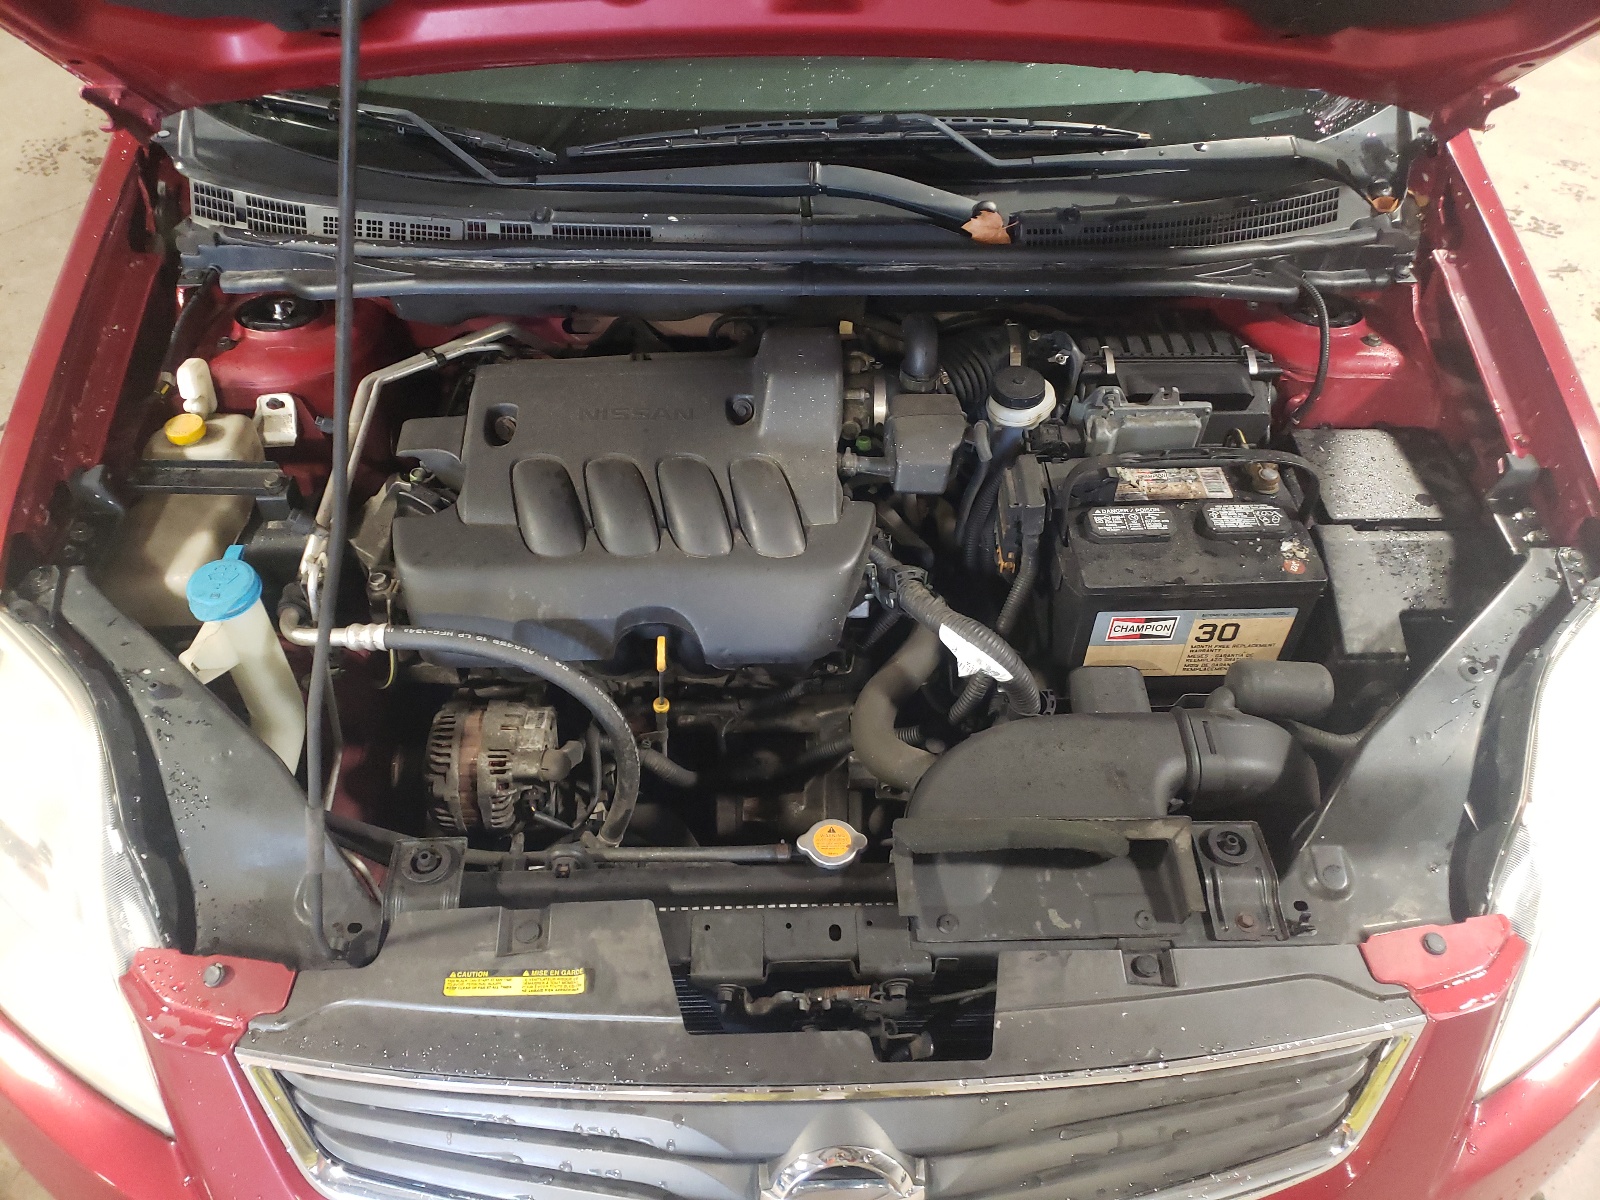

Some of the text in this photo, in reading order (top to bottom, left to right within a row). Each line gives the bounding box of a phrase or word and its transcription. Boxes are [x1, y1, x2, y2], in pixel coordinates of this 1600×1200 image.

[581, 408, 694, 421] NISSAN
[1113, 624, 1172, 633] CHAMPION
[1195, 623, 1240, 643] 30
